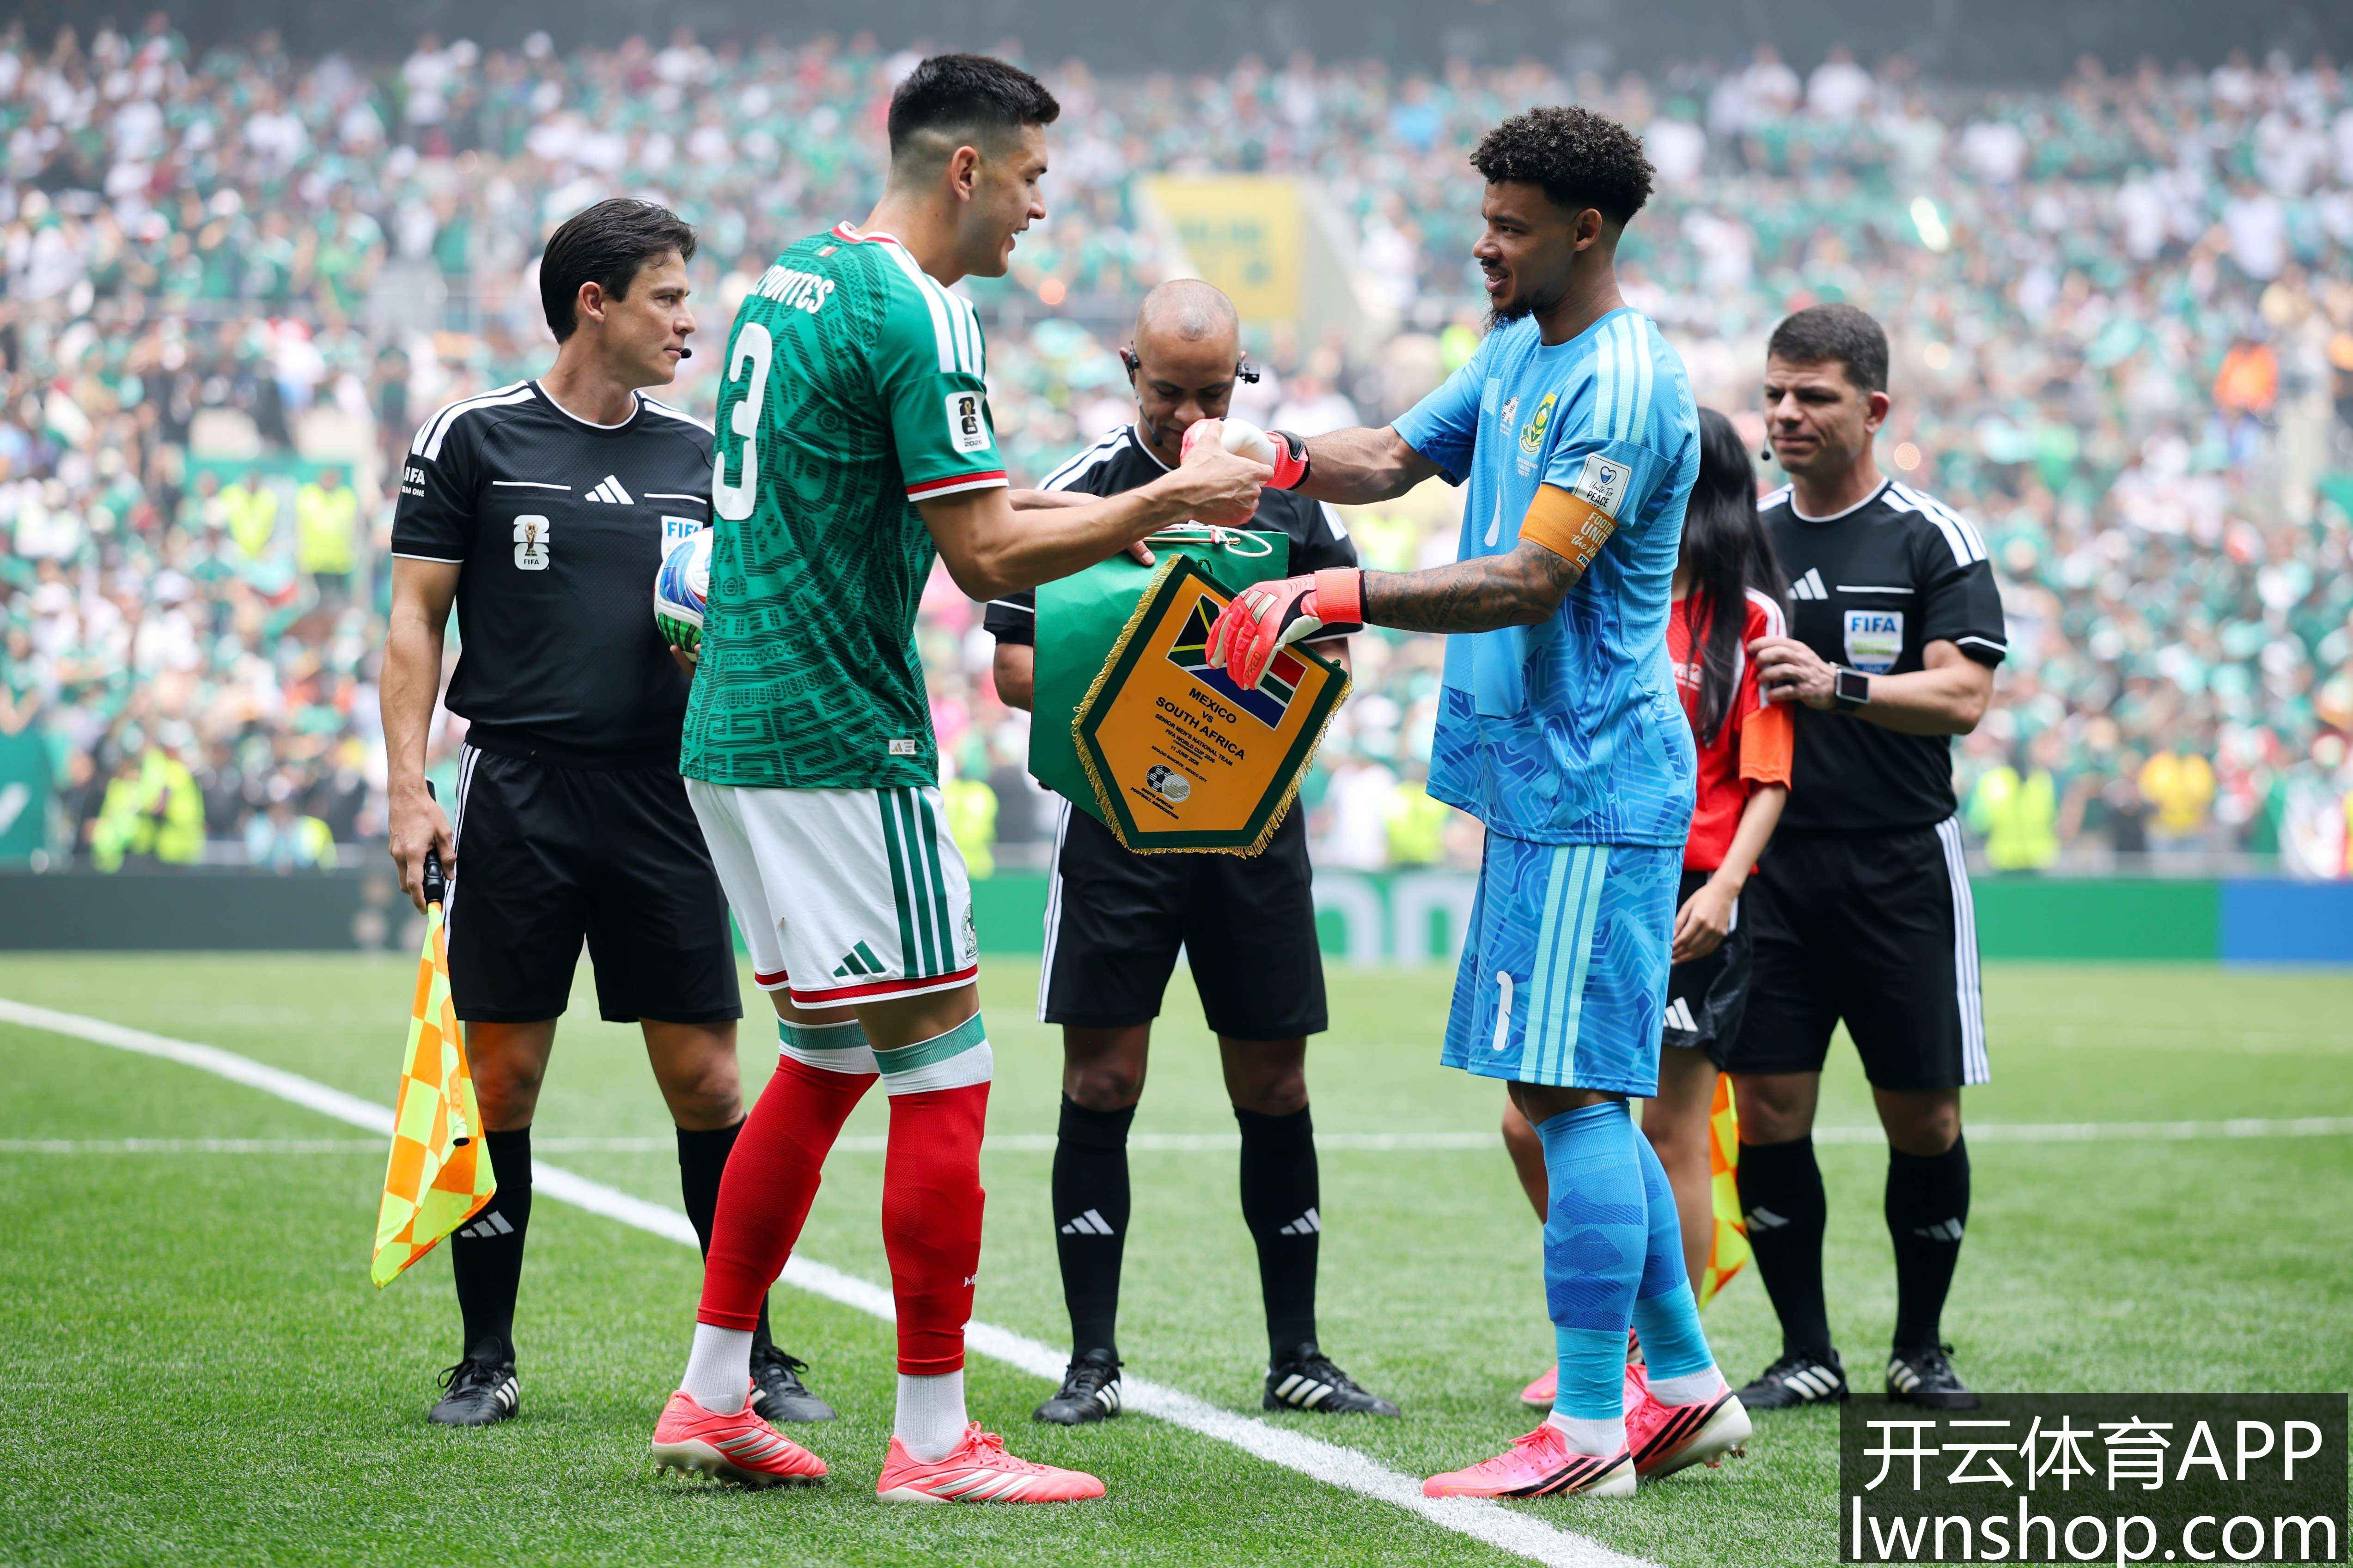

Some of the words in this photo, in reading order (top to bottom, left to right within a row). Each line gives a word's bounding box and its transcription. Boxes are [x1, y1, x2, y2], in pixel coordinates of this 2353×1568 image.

[712, 322, 773, 521] 3
[404, 466, 425, 485] IFA
[412, 488, 425, 497] ONE
[1589, 480, 1606, 493] Unite
[1586, 490, 1609, 507] PEACE
[1571, 535, 1587, 549] the
[1852, 616, 1896, 632] FIFA
[1189, 687, 1237, 723] MEXICO
[1202, 711, 1214, 723] VS
[1156, 697, 1200, 729] SOUTH
[1199, 726, 1245, 760] AFRICA
[1155, 713, 1176, 729] SENIOR
[1175, 726, 1192, 739] MEN'S
[1192, 736, 1217, 756] NATIONAL
[1219, 754, 1233, 766] TEAM
[1165, 729, 1176, 738] FIFA
[1176, 735, 1194, 749] WORLD
[1194, 747, 1204, 755] CUP
[1204, 754, 1215, 763] 2026
[1176, 749, 1189, 760] JUNE
[1188, 757, 1200, 766] 2026
[1185, 766, 1198, 778] MEXICO
[1131, 786, 1152, 803] FOOTBALL
[1152, 801, 1179, 820] ASSOCIATION
[1141, 787, 1156, 798] SOUTH
[1155, 796, 1174, 810] AFRICAN
[1493, 970, 1513, 1051] 1
